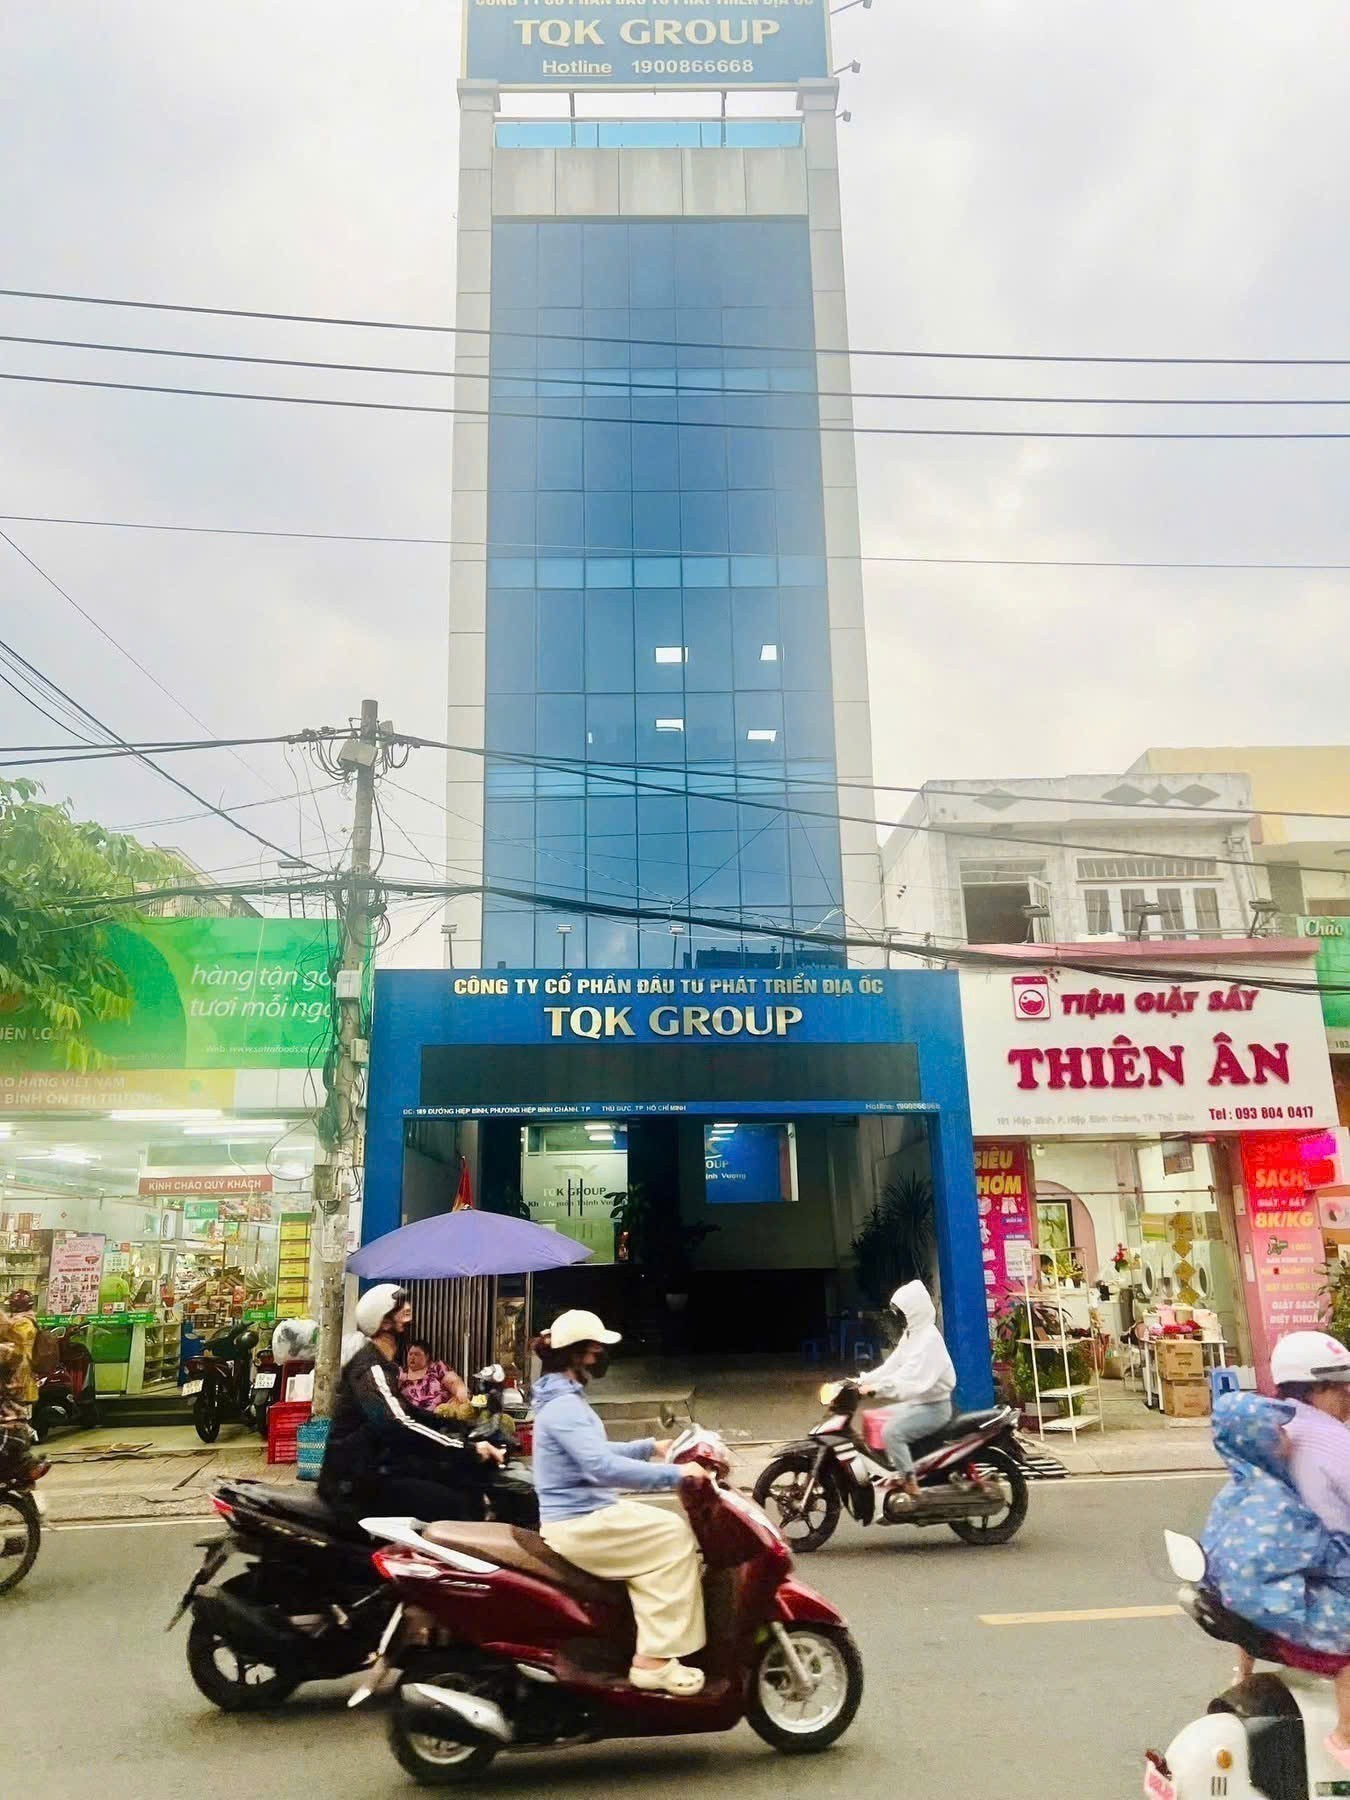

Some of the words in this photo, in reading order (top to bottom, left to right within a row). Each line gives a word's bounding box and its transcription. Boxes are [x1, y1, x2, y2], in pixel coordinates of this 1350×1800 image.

[513, 19, 605, 47] TQK
[619, 19, 780, 45] GROUP
[542, 60, 612, 75] Hotline
[631, 59, 754, 74] 1900866668
[191, 964, 254, 991] hàng
[259, 965, 297, 990] tận
[454, 976, 508, 994] CÔNG
[514, 979, 539, 994] TY
[545, 972, 573, 994] CỔ
[577, 973, 632, 994] PHẦN
[636, 974, 675, 994] ĐẦU
[680, 977, 704, 994] TƯ
[710, 975, 757, 994] PHÁT
[763, 972, 817, 994] TRIỂN
[822, 978, 854, 997] ĐỊA
[858, 974, 884, 994] ỐC
[240, 994, 288, 1017] mỗi
[1061, 987, 1126, 1020] TIỆM
[1134, 984, 1200, 1019] GIẶT
[1207, 983, 1260, 1012] SẤY
[543, 1006, 636, 1040] TQK
[648, 1005, 803, 1037] GROUP
[1008, 1034, 1185, 1090] THIÊN
[1208, 1030, 1290, 1086] ÂN
[1235, 1107, 1258, 1120] 093
[1261, 1106, 1284, 1120] 804
[1287, 1105, 1314, 1119] 0417
[148, 1181, 172, 1191] KÍNH
[174, 1179, 202, 1190] CHÀO
[227, 1179, 261, 1189] KHÁCH
[977, 1171, 1022, 1195] HƠM
[1255, 1211, 1314, 1228] 8K/KG
